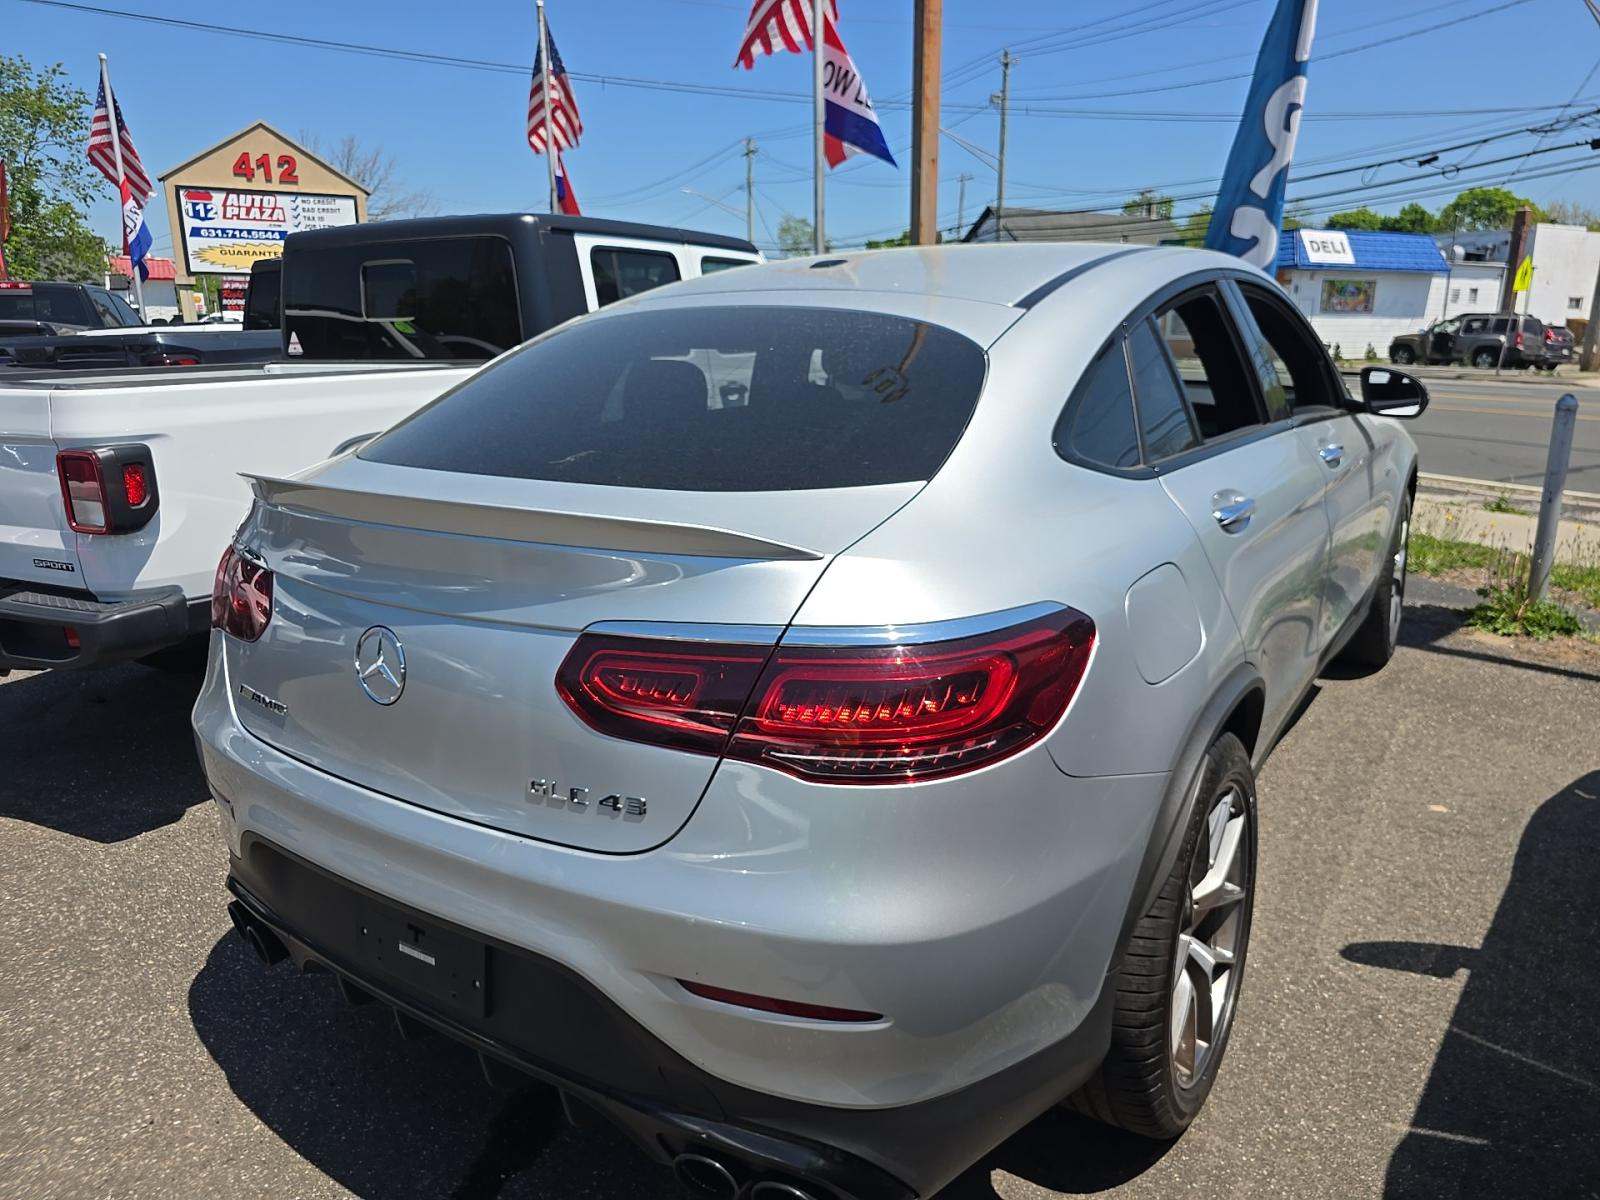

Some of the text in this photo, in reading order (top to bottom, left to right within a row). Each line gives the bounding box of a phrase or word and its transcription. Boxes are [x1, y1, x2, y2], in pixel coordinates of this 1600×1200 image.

[233, 152, 299, 184] 412
[225, 193, 275, 207] AUTO
[185, 202, 218, 219] 112
[225, 206, 285, 221] PLAZA
[200, 228, 280, 240] 631.714.5544
[1309, 240, 1347, 254] DELI
[33, 558, 75, 572] SPORT
[529, 778, 648, 816] GLC 43
